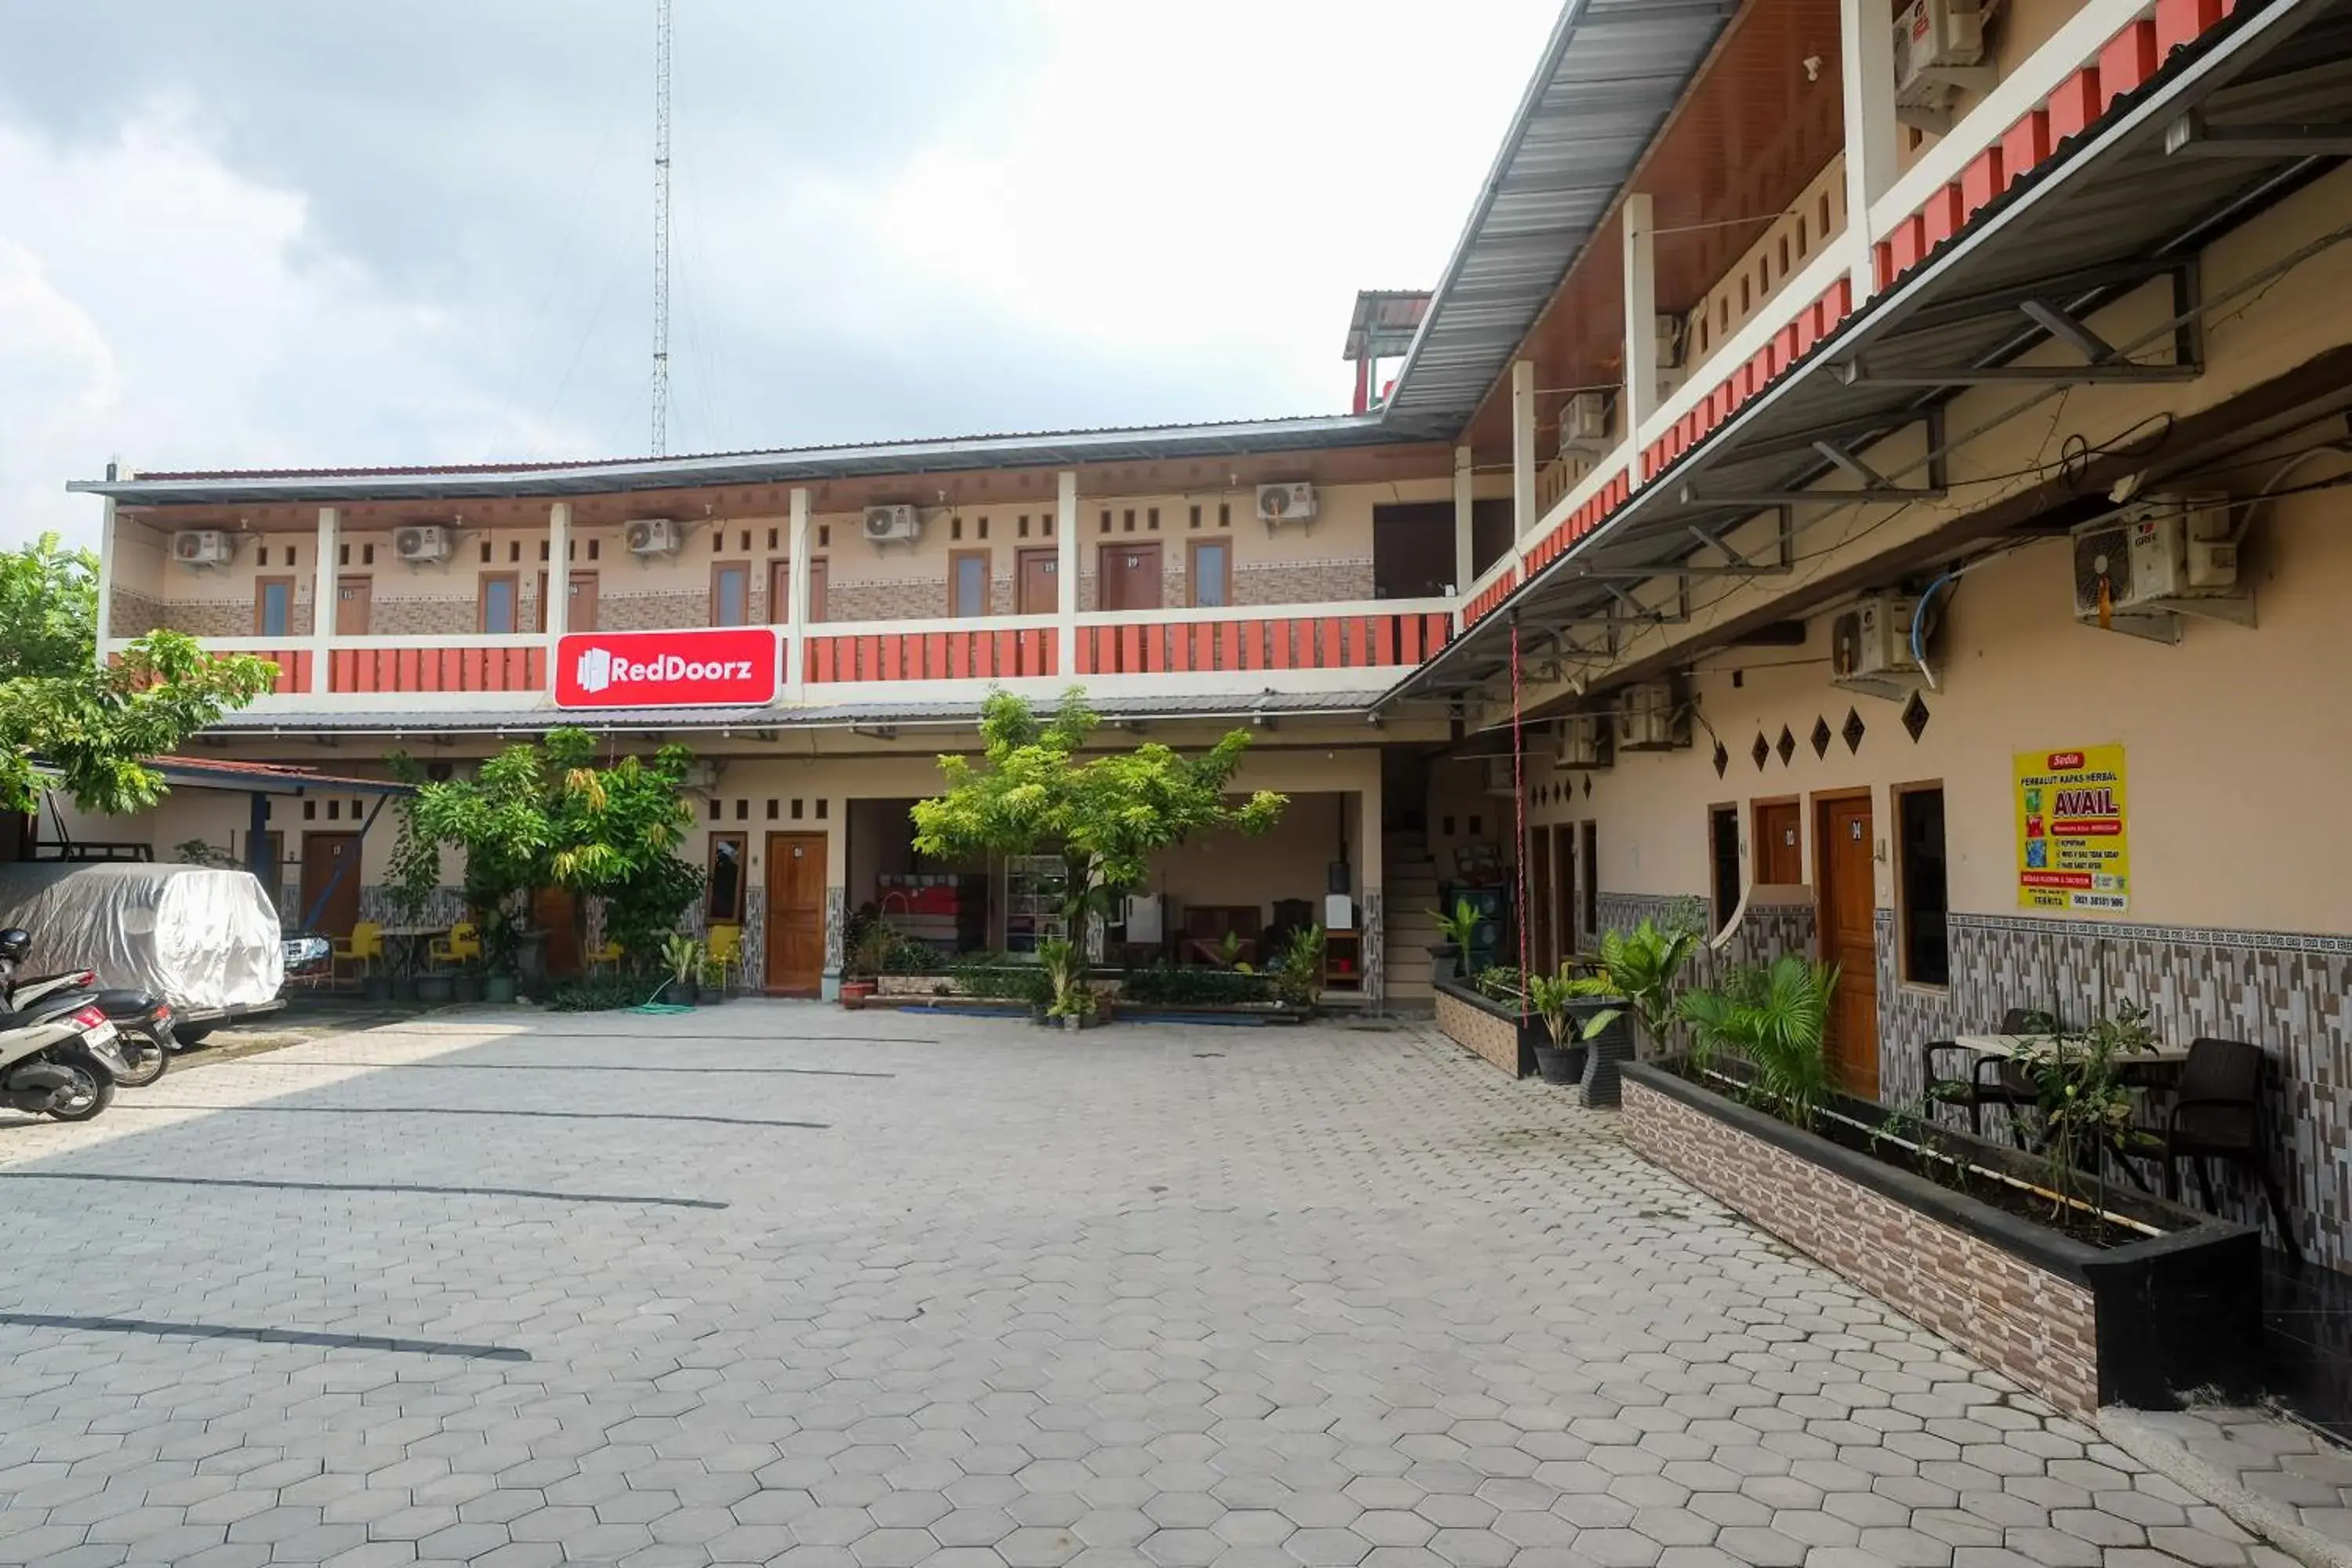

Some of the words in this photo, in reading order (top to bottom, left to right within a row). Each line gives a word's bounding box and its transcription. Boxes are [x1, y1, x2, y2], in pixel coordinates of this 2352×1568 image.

[612, 654, 753, 682] RedDoorz
[2053, 754, 2078, 766] Sedia
[2020, 775, 2057, 786] PEMBALUT
[2054, 788, 2119, 817] AVAIL
